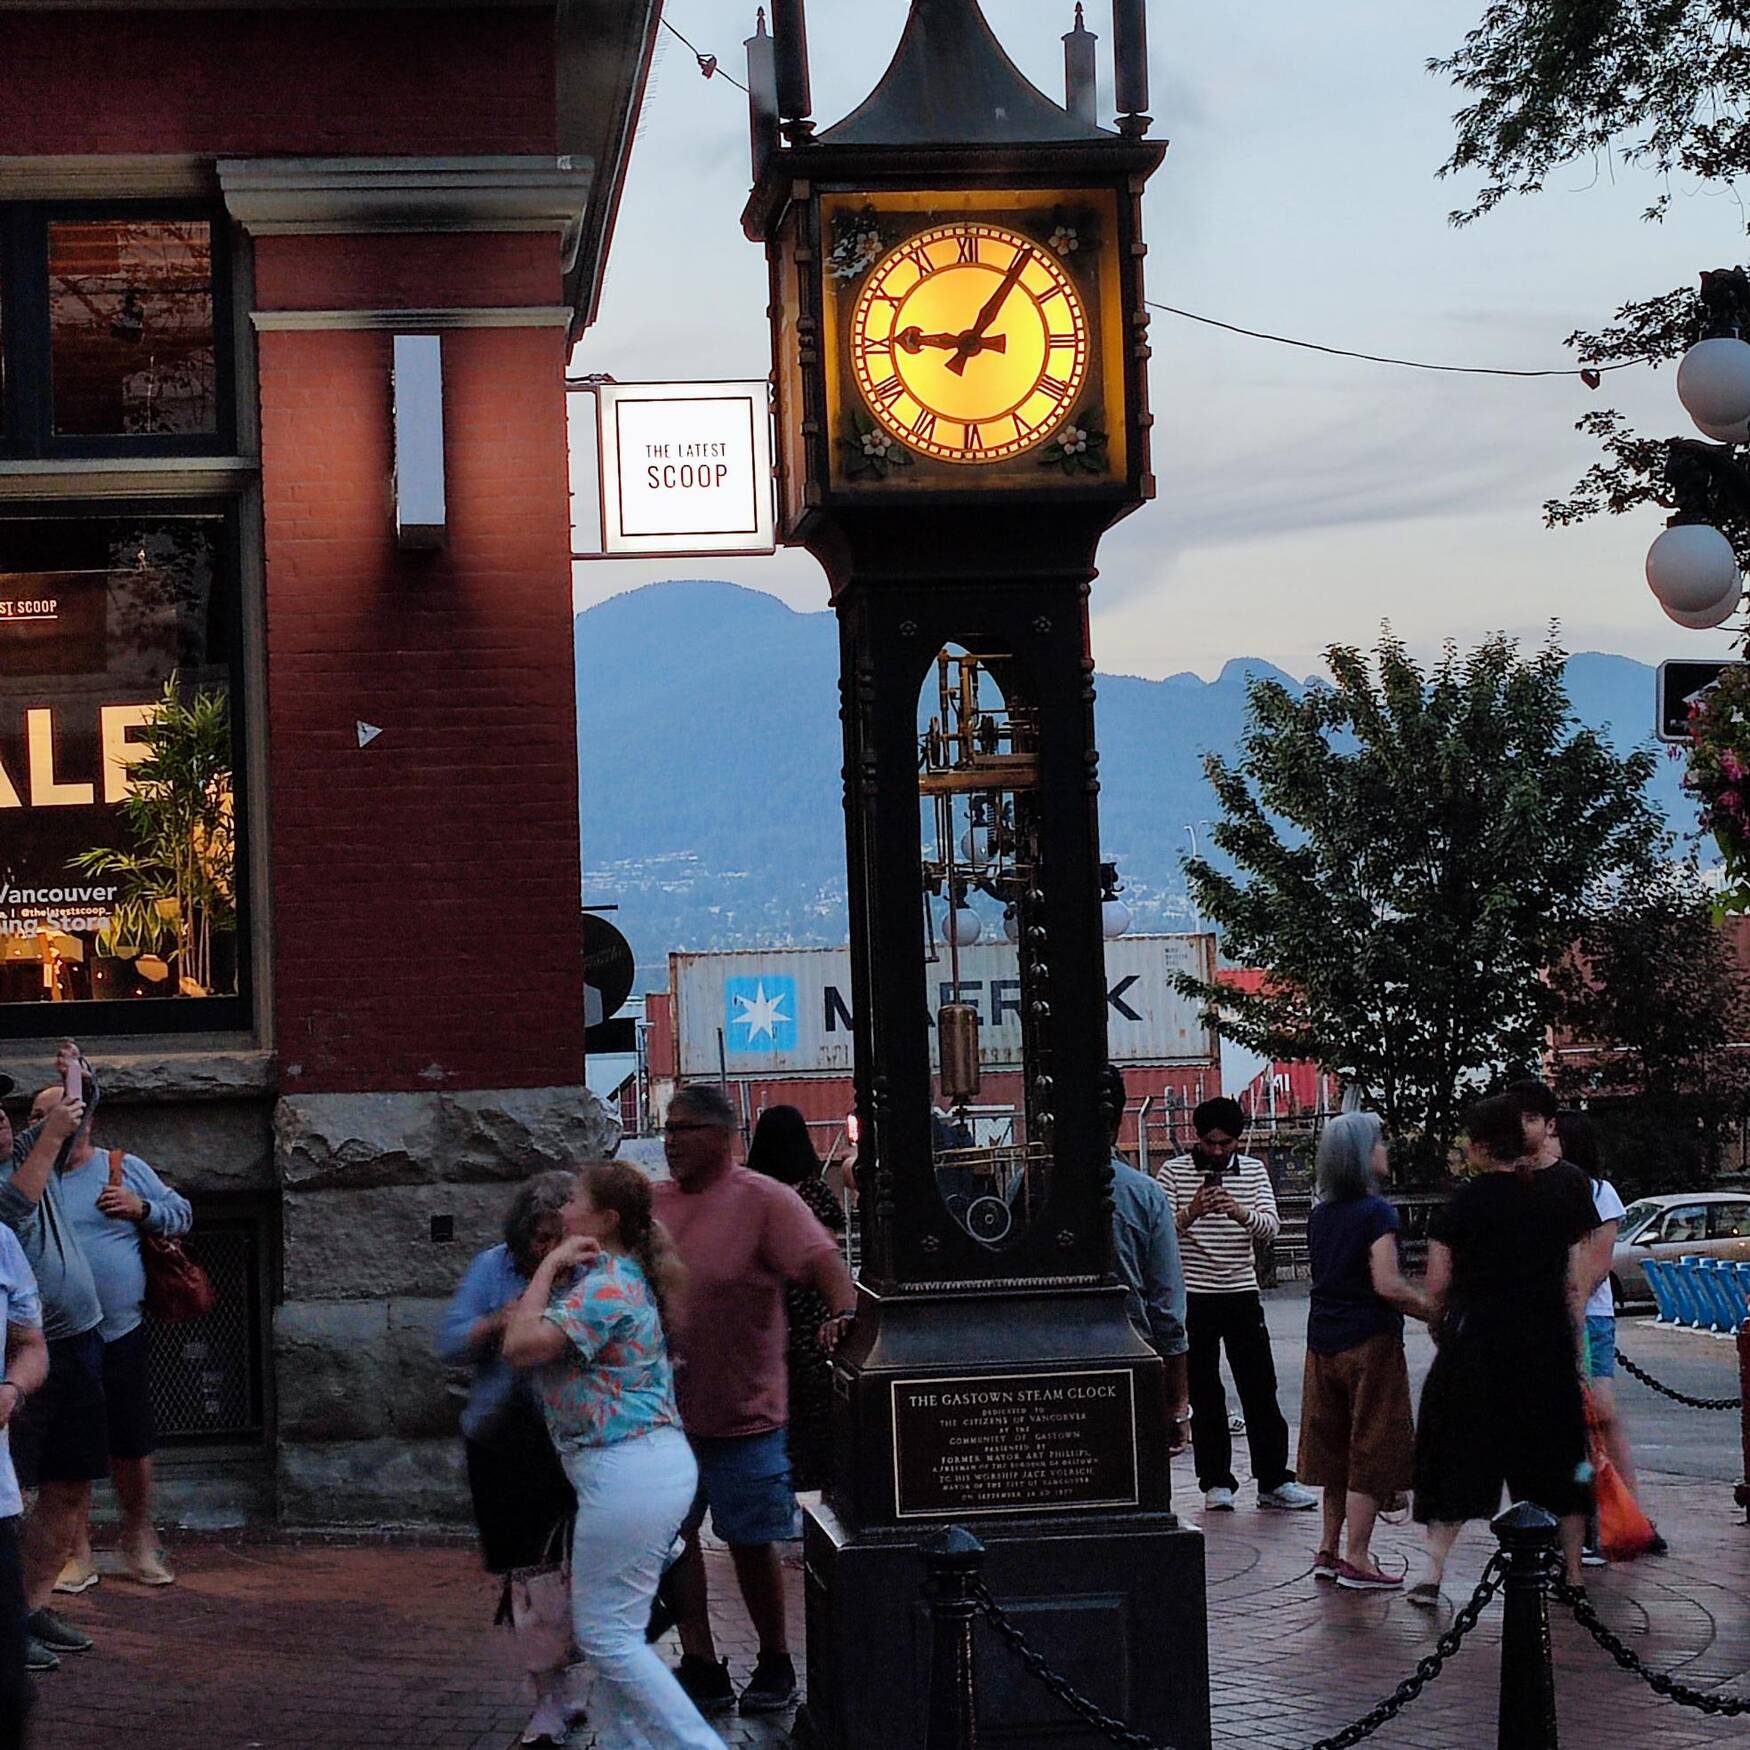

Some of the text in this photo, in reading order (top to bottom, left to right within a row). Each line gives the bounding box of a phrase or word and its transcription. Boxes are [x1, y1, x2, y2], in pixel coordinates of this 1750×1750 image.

[645, 443, 725, 458] THE LATEST
[648, 463, 727, 489] SCOOP
[17, 600, 57, 613] SCOOP
[0, 882, 117, 904] Vancouver
[825, 976, 1143, 1031] MERK
[909, 1385, 1116, 1407] THE GASTOWN STEAM CLOCK
[939, 1418, 956, 1427] THE
[962, 1416, 1007, 1426] CITIZENS
[1034, 1430, 1079, 1440] GASTOWN
